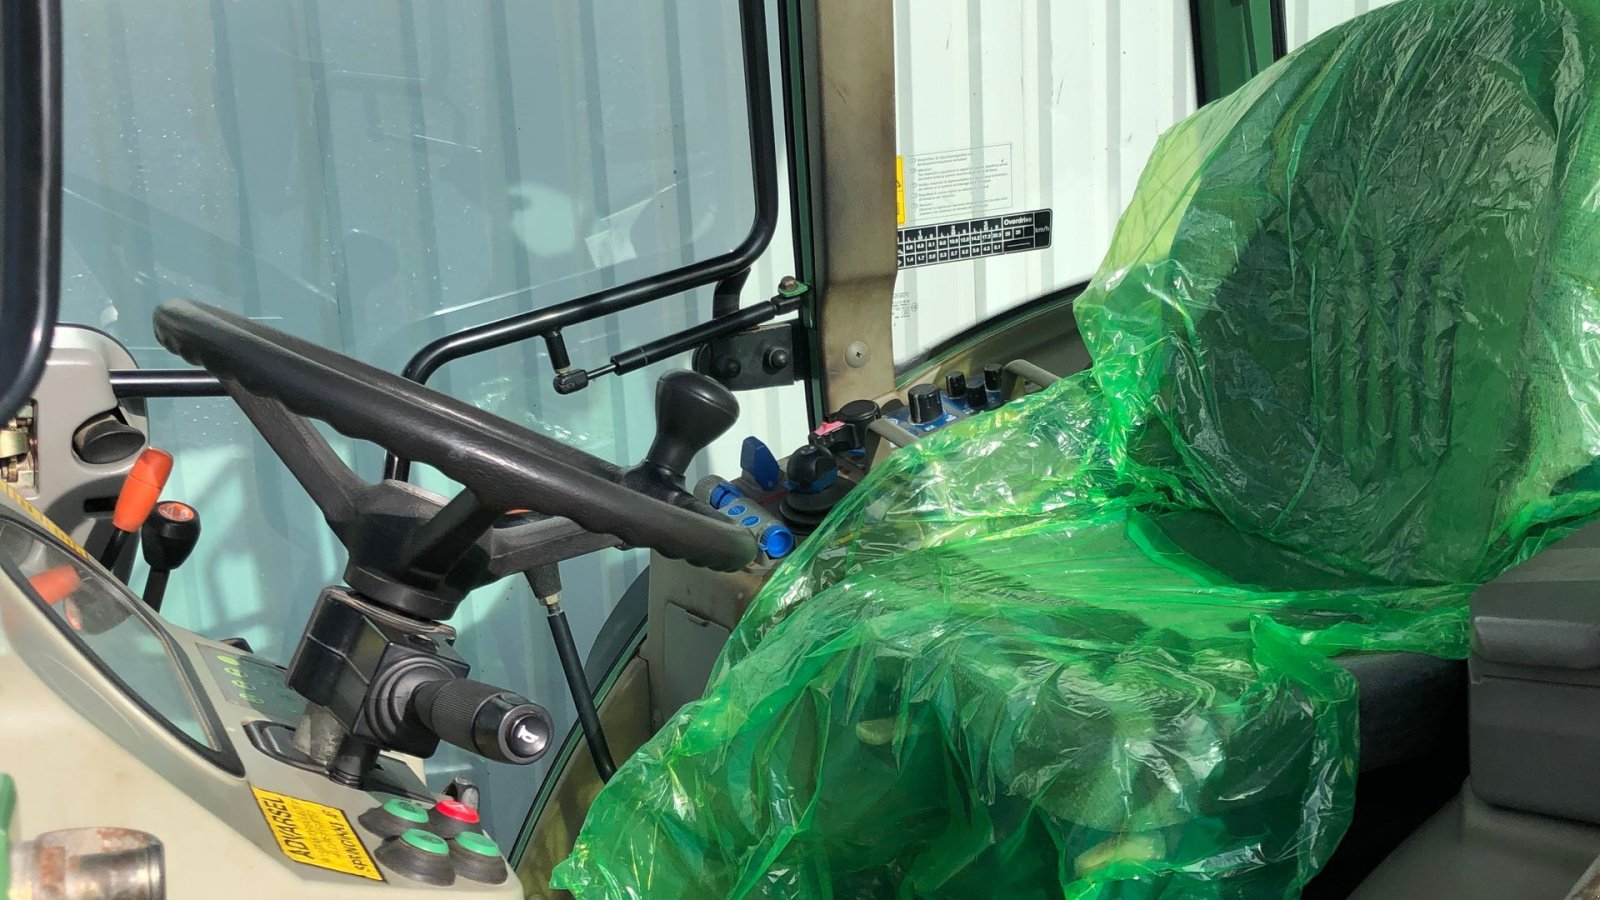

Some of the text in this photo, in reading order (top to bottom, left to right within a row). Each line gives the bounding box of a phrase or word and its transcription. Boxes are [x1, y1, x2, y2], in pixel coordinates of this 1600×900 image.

[1004, 216, 1032, 226] Overdrive
[1035, 225, 1050, 233] km/h
[262, 798, 316, 860] ADVARSEL
